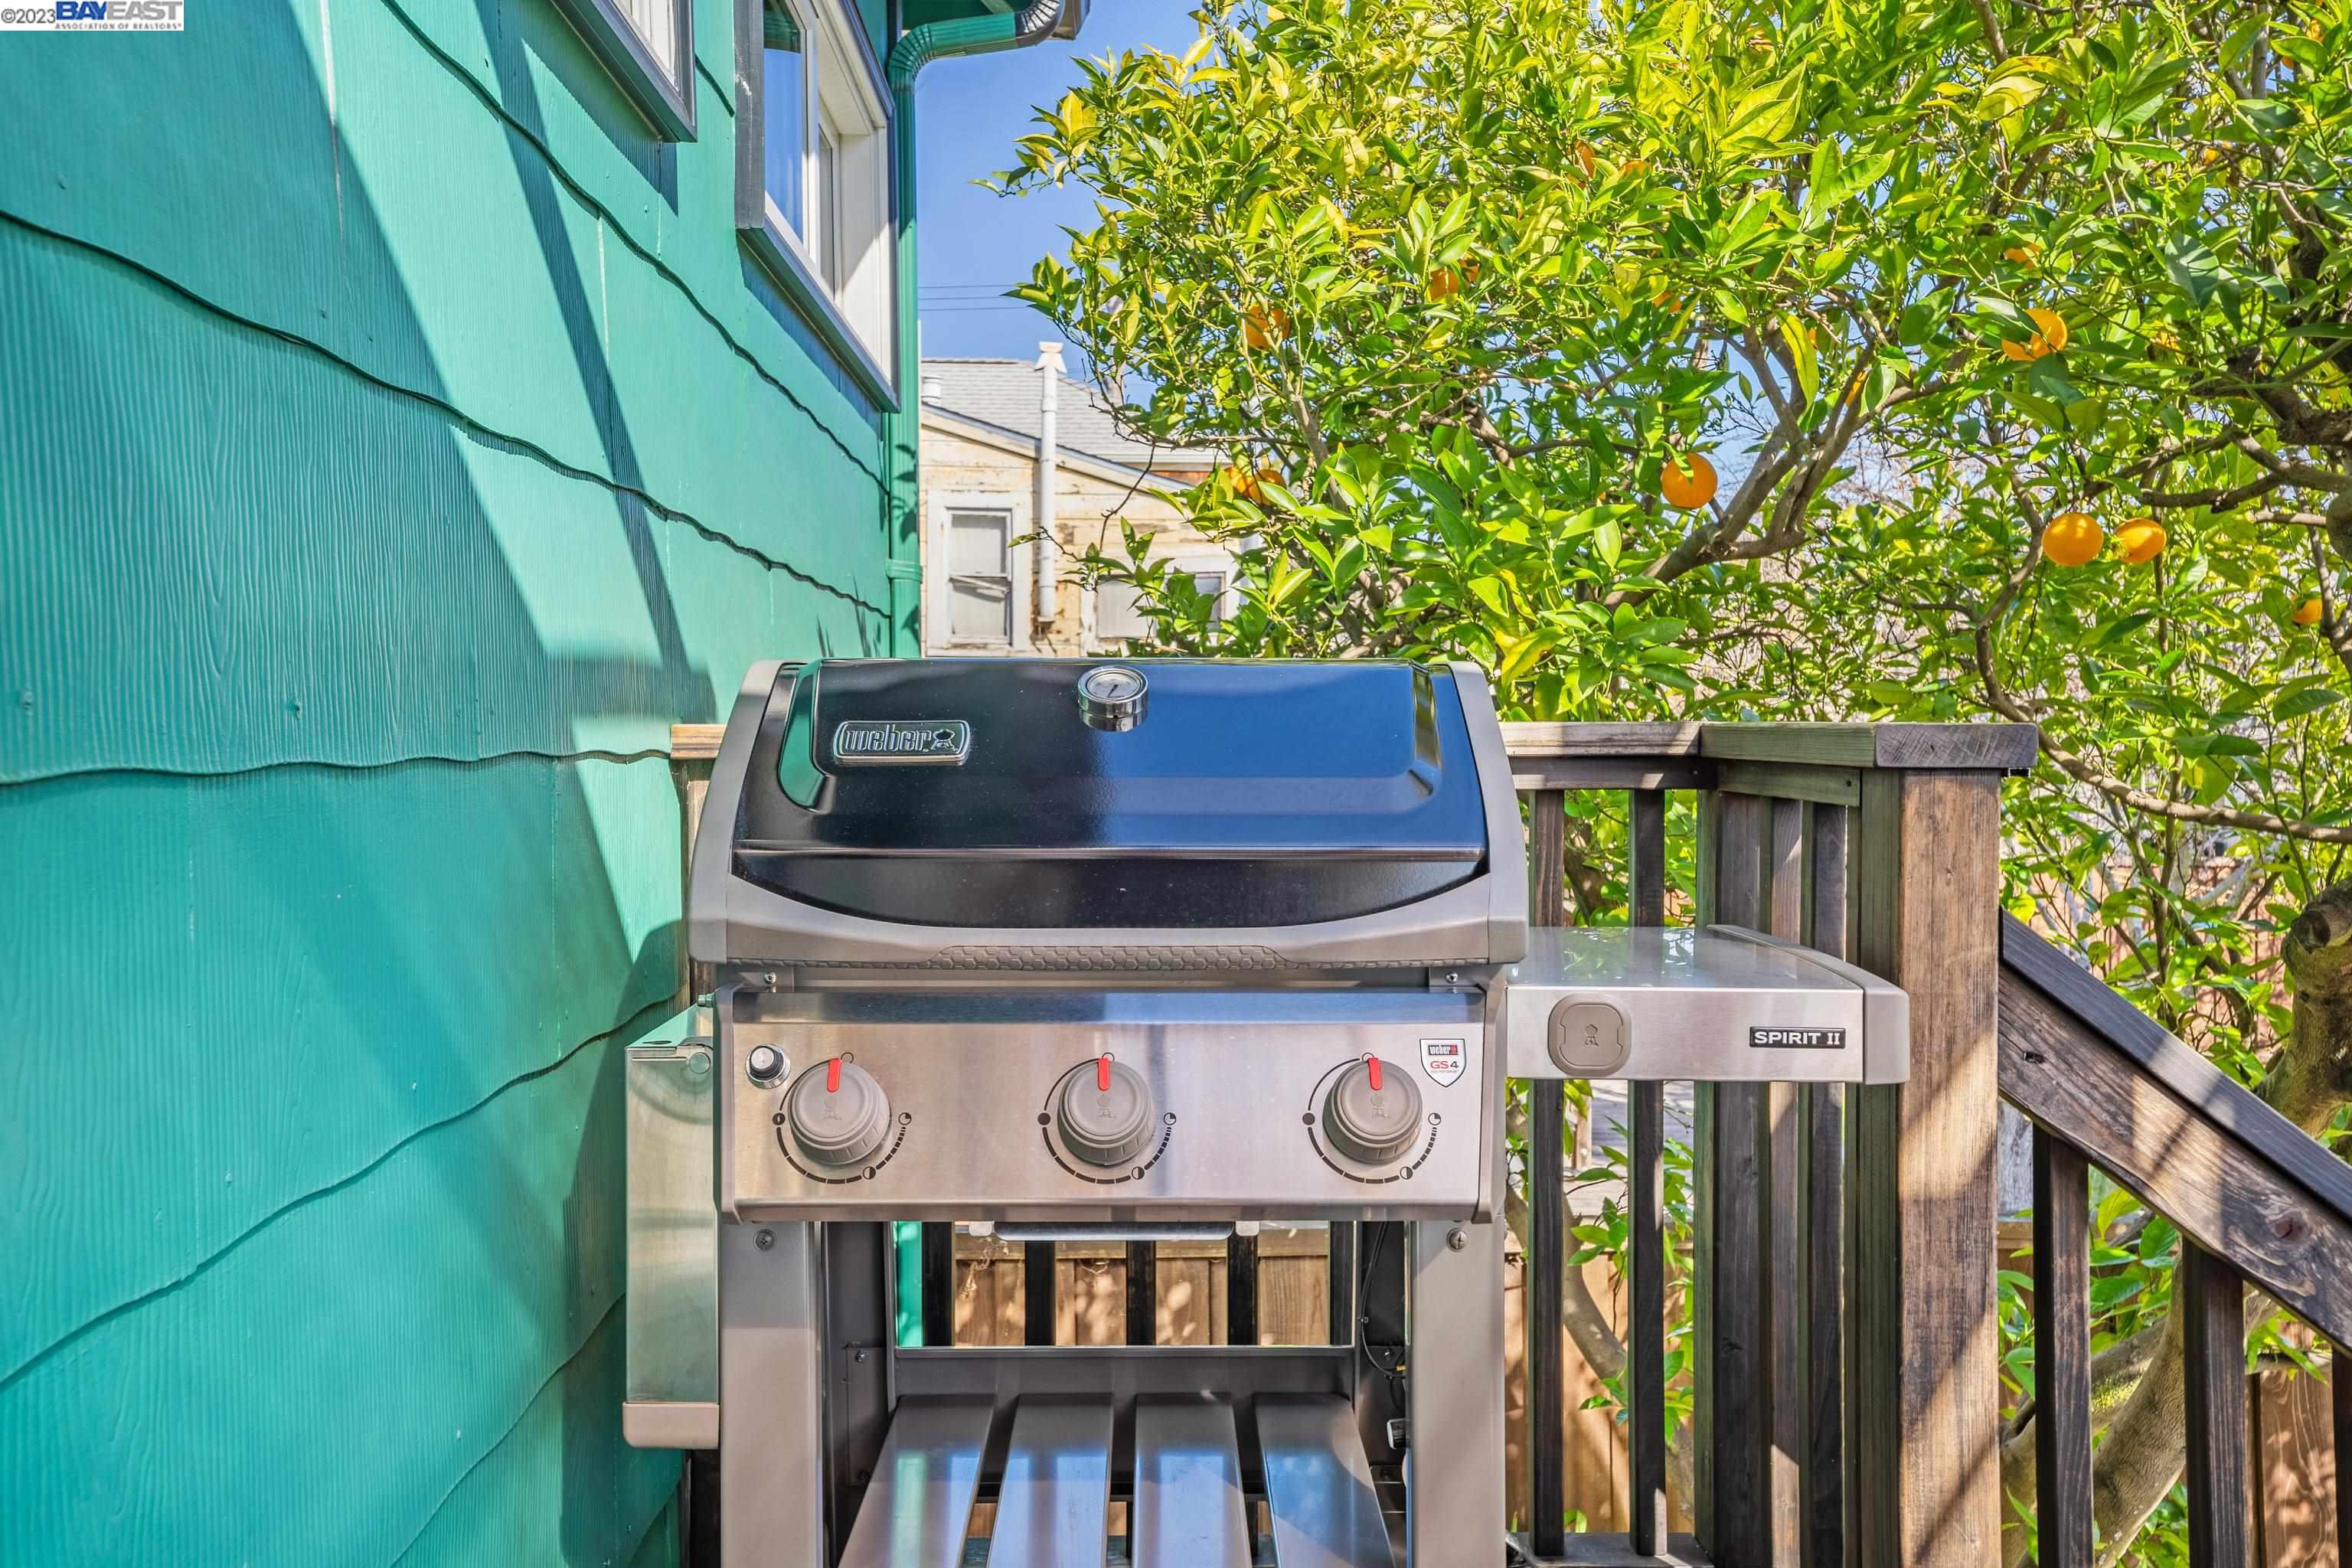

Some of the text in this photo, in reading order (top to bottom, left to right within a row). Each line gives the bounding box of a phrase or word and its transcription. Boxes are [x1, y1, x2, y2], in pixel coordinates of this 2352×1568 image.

[844, 724, 932, 751] weber
[1754, 1031, 1841, 1045] SPIRIT II
[1429, 1044, 1451, 1055] weber
